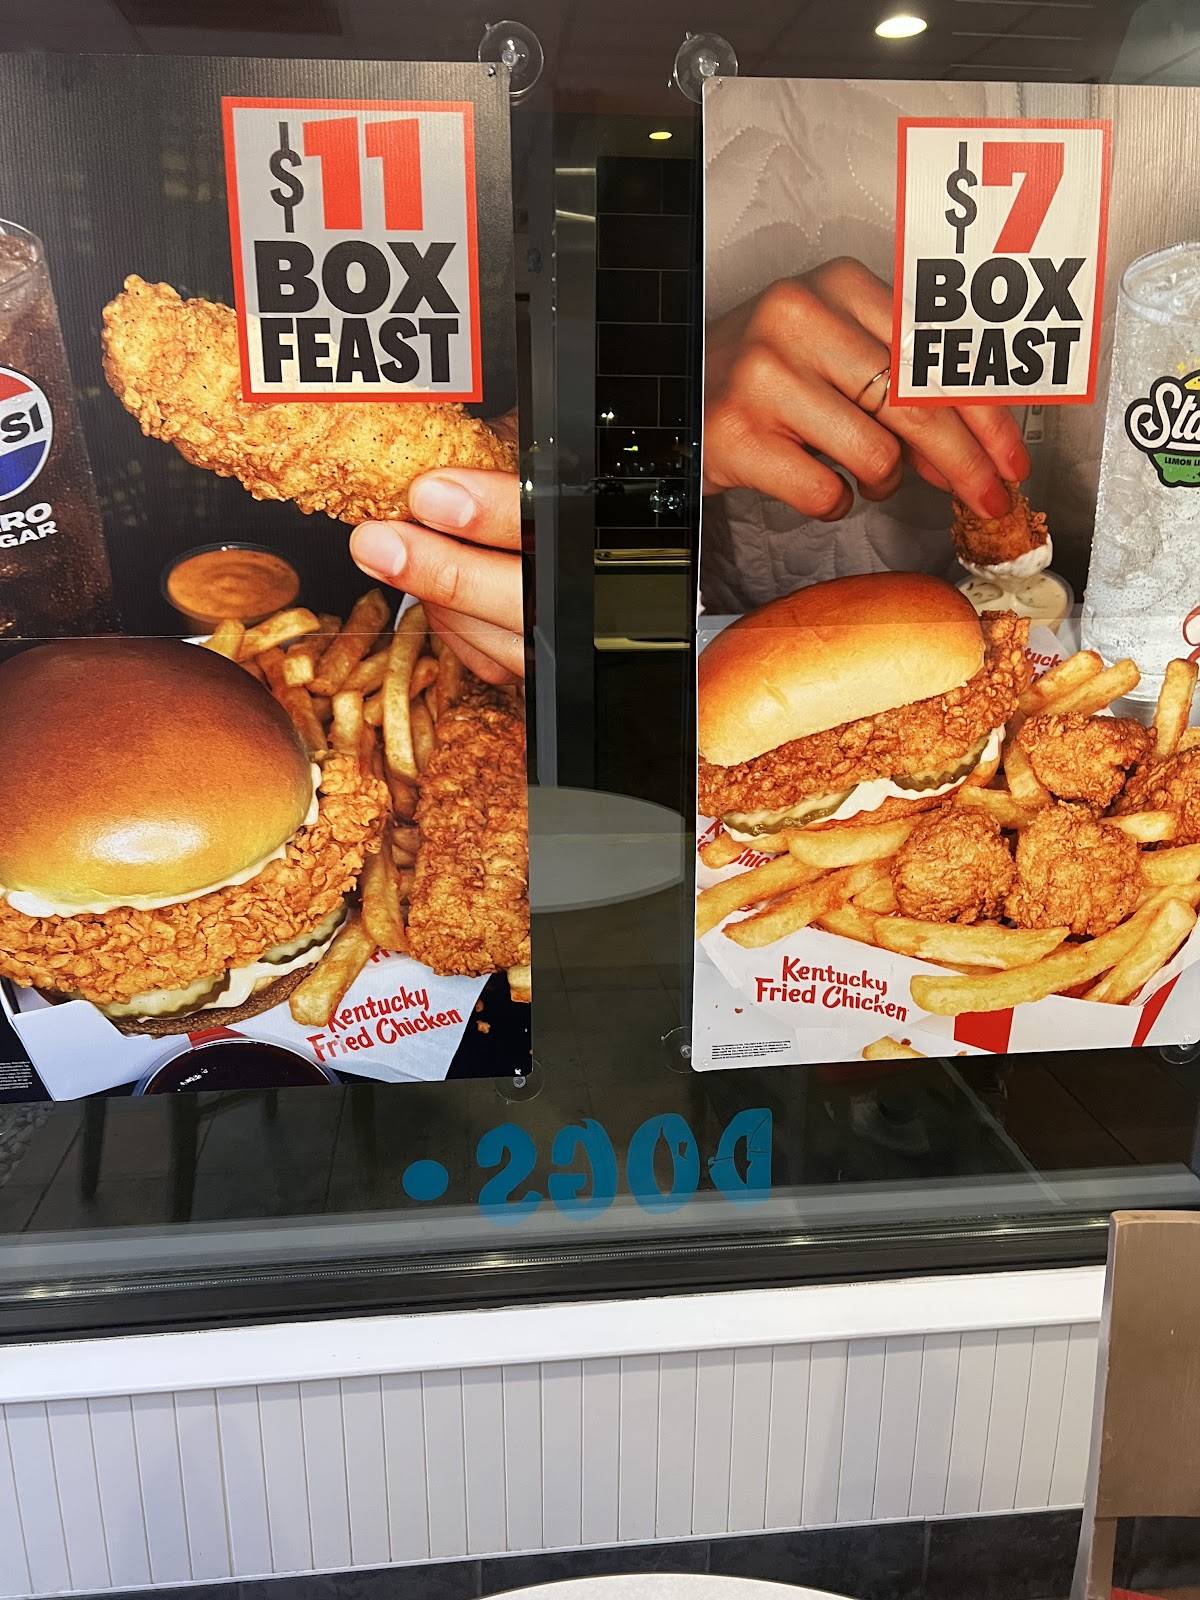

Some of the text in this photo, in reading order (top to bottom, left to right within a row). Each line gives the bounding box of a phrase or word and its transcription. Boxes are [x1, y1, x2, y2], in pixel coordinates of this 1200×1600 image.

[269, 116, 424, 233] $11
[944, 141, 1065, 253] $7
[254, 240, 461, 314] BOX
[914, 257, 1087, 323] BOX
[259, 317, 459, 383] FEAST
[911, 327, 1081, 387] FEAST
[1164, 457, 1192, 466] LEMON
[0, 502, 52, 532] RO
[755, 976, 908, 1022] Fried Chicken
[782, 955, 888, 996] Kentucky
[306, 1008, 464, 1062] Fried Chicken
